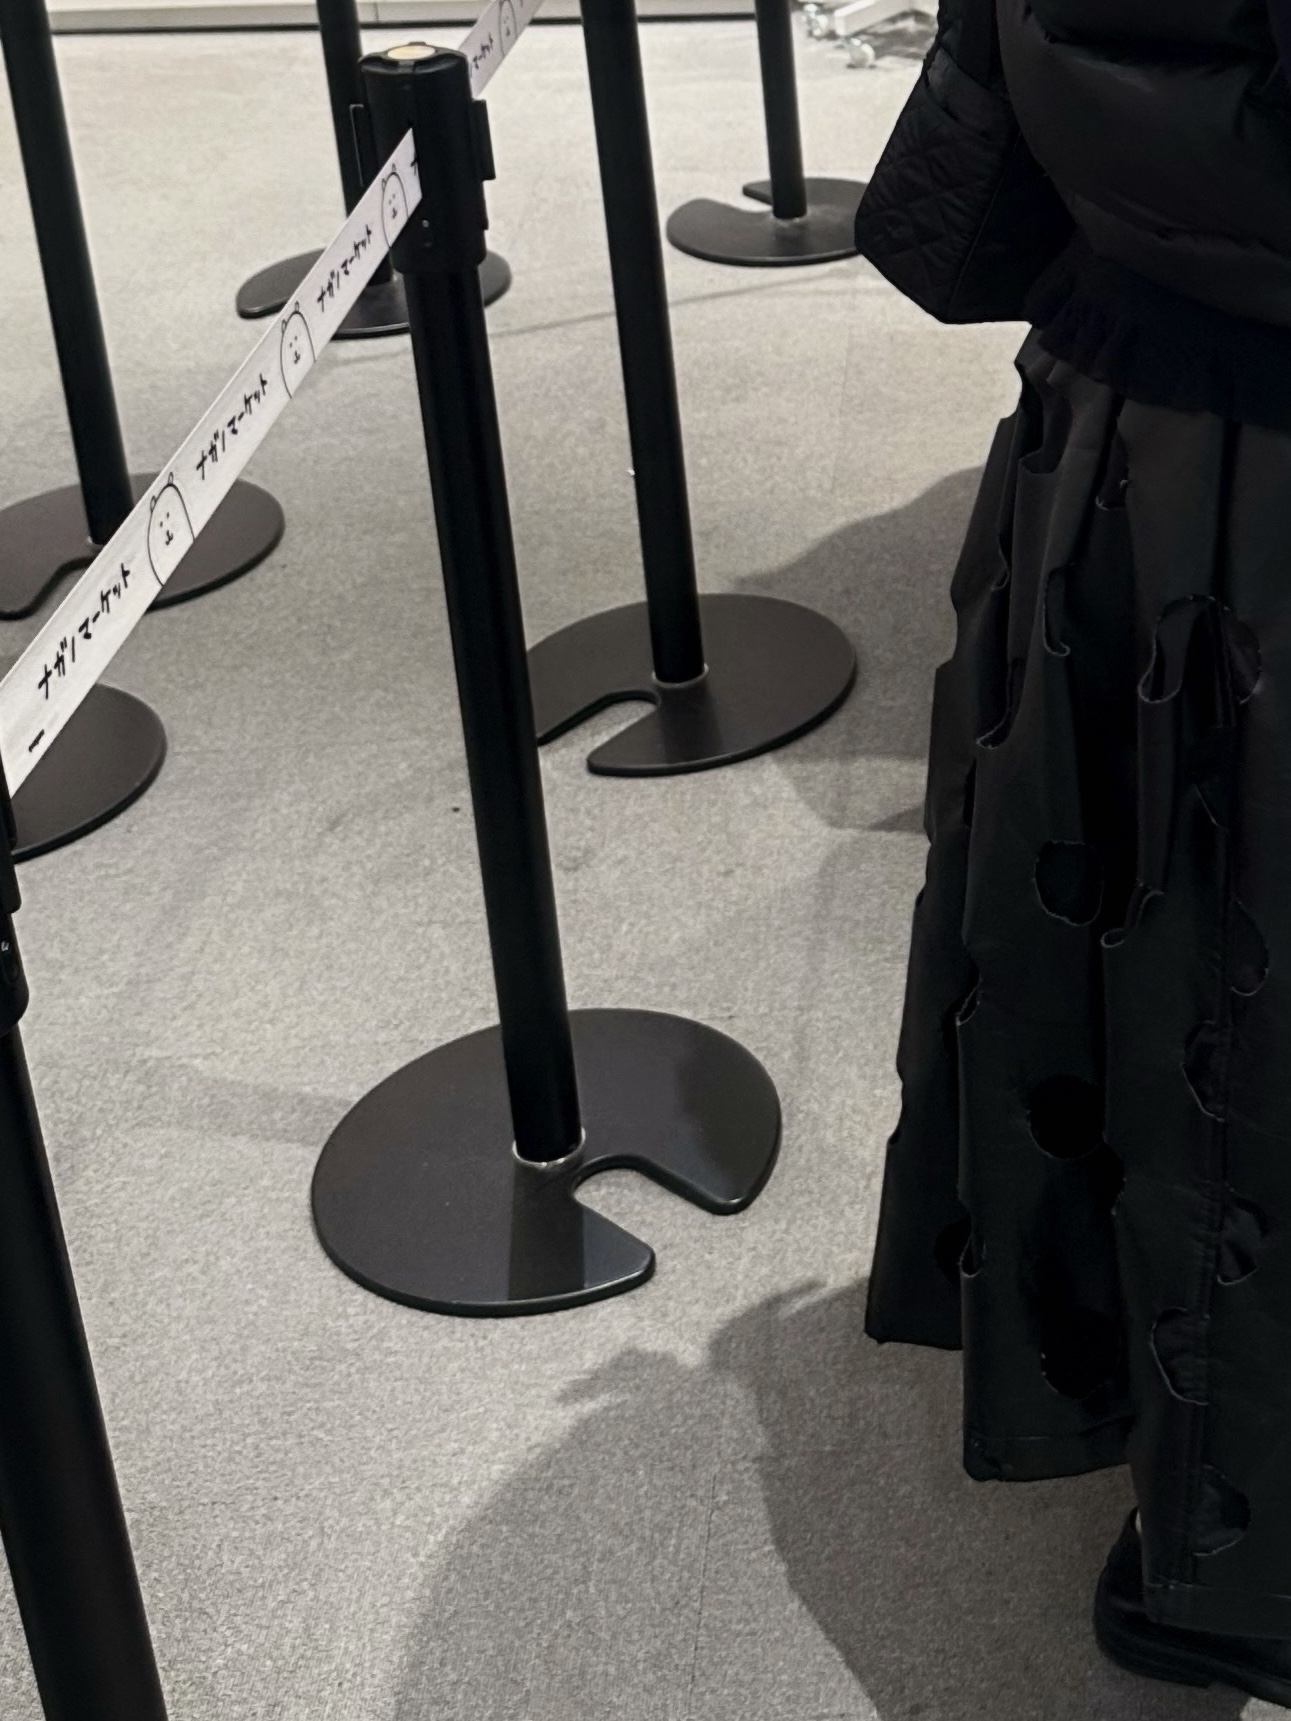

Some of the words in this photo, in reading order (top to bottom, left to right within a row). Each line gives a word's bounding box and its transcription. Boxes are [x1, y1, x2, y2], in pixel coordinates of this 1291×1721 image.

[317, 223, 372, 313] ナガノマーケット
[196, 372, 268, 481] ナガノマーケット
[37, 562, 130, 700] ナガノマーケット
